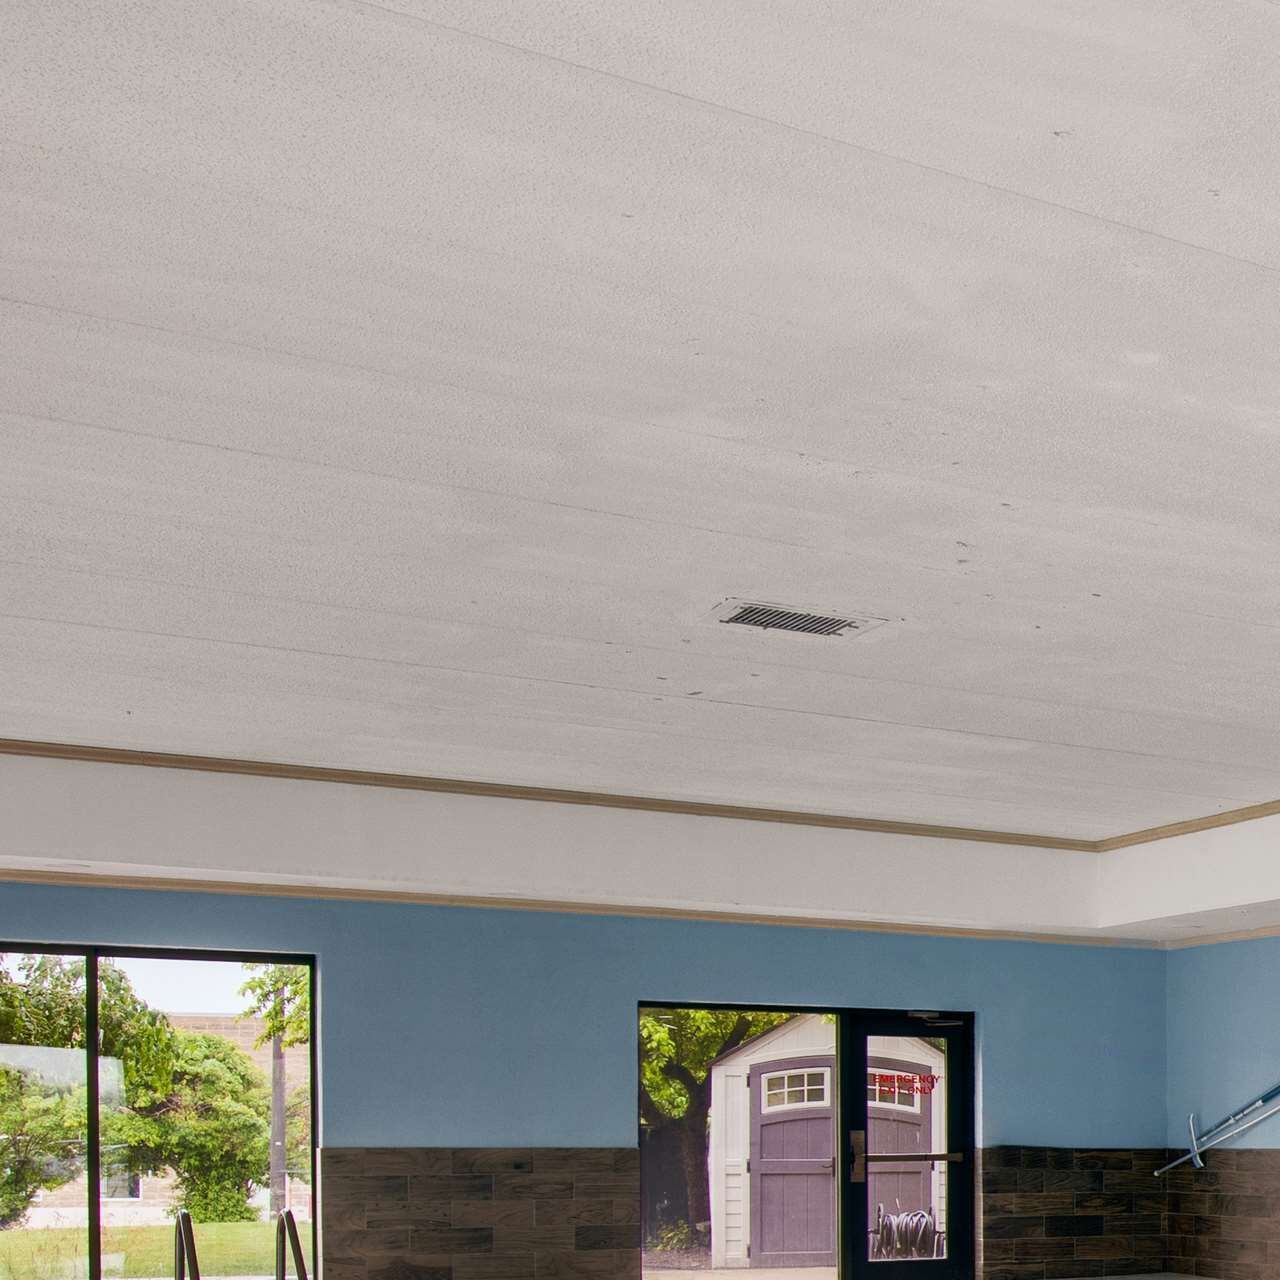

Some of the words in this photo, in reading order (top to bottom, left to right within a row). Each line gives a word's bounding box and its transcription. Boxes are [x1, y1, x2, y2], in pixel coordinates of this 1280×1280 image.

[872, 1074, 940, 1083] EMERGENCY
[880, 1086, 902, 1095] EXIT
[908, 1086, 933, 1095] ONLY
